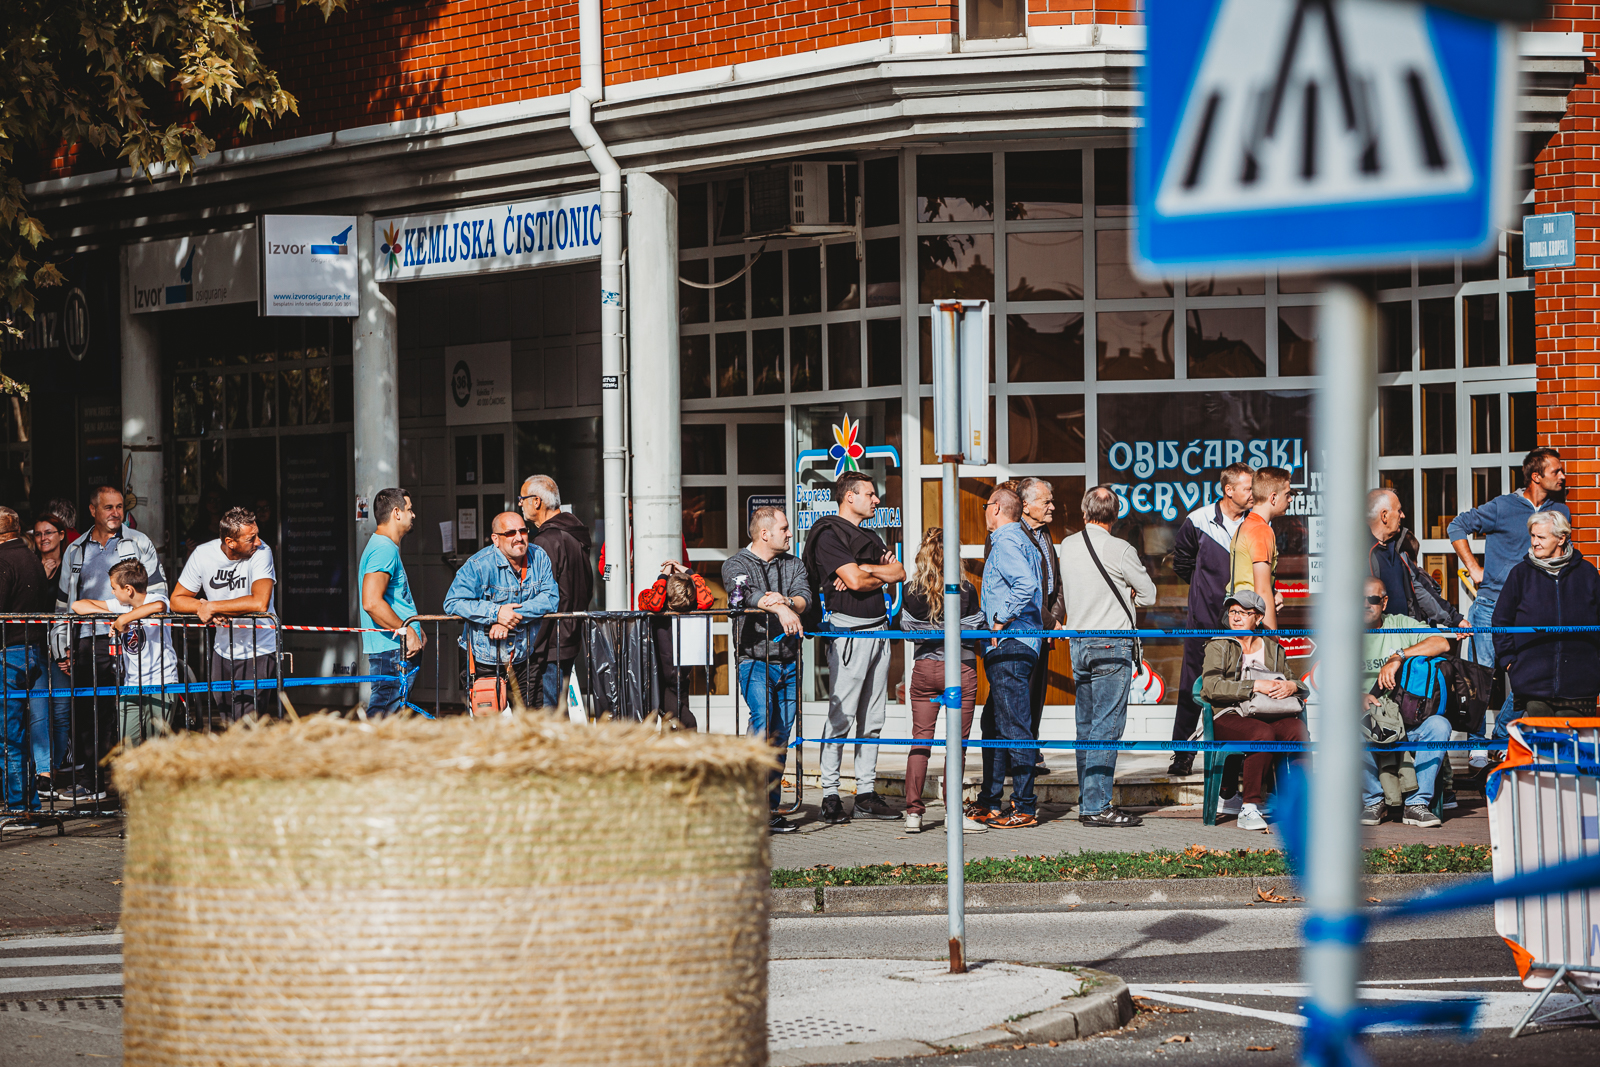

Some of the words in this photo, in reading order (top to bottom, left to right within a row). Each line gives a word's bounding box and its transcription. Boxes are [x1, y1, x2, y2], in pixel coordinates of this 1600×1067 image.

[403, 218, 497, 267] KEMIJSKA
[503, 204, 601, 256] ČISTIONIC
[268, 241, 306, 255] Izvor
[134, 284, 162, 308] Izvor
[196, 284, 228, 304] osiguranje
[273, 293, 351, 302] www.izvorosiguranje.hr
[456, 375, 466, 389] 36
[1108, 438, 1303, 480] OBUĆARSKI
[796, 484, 832, 506] Express
